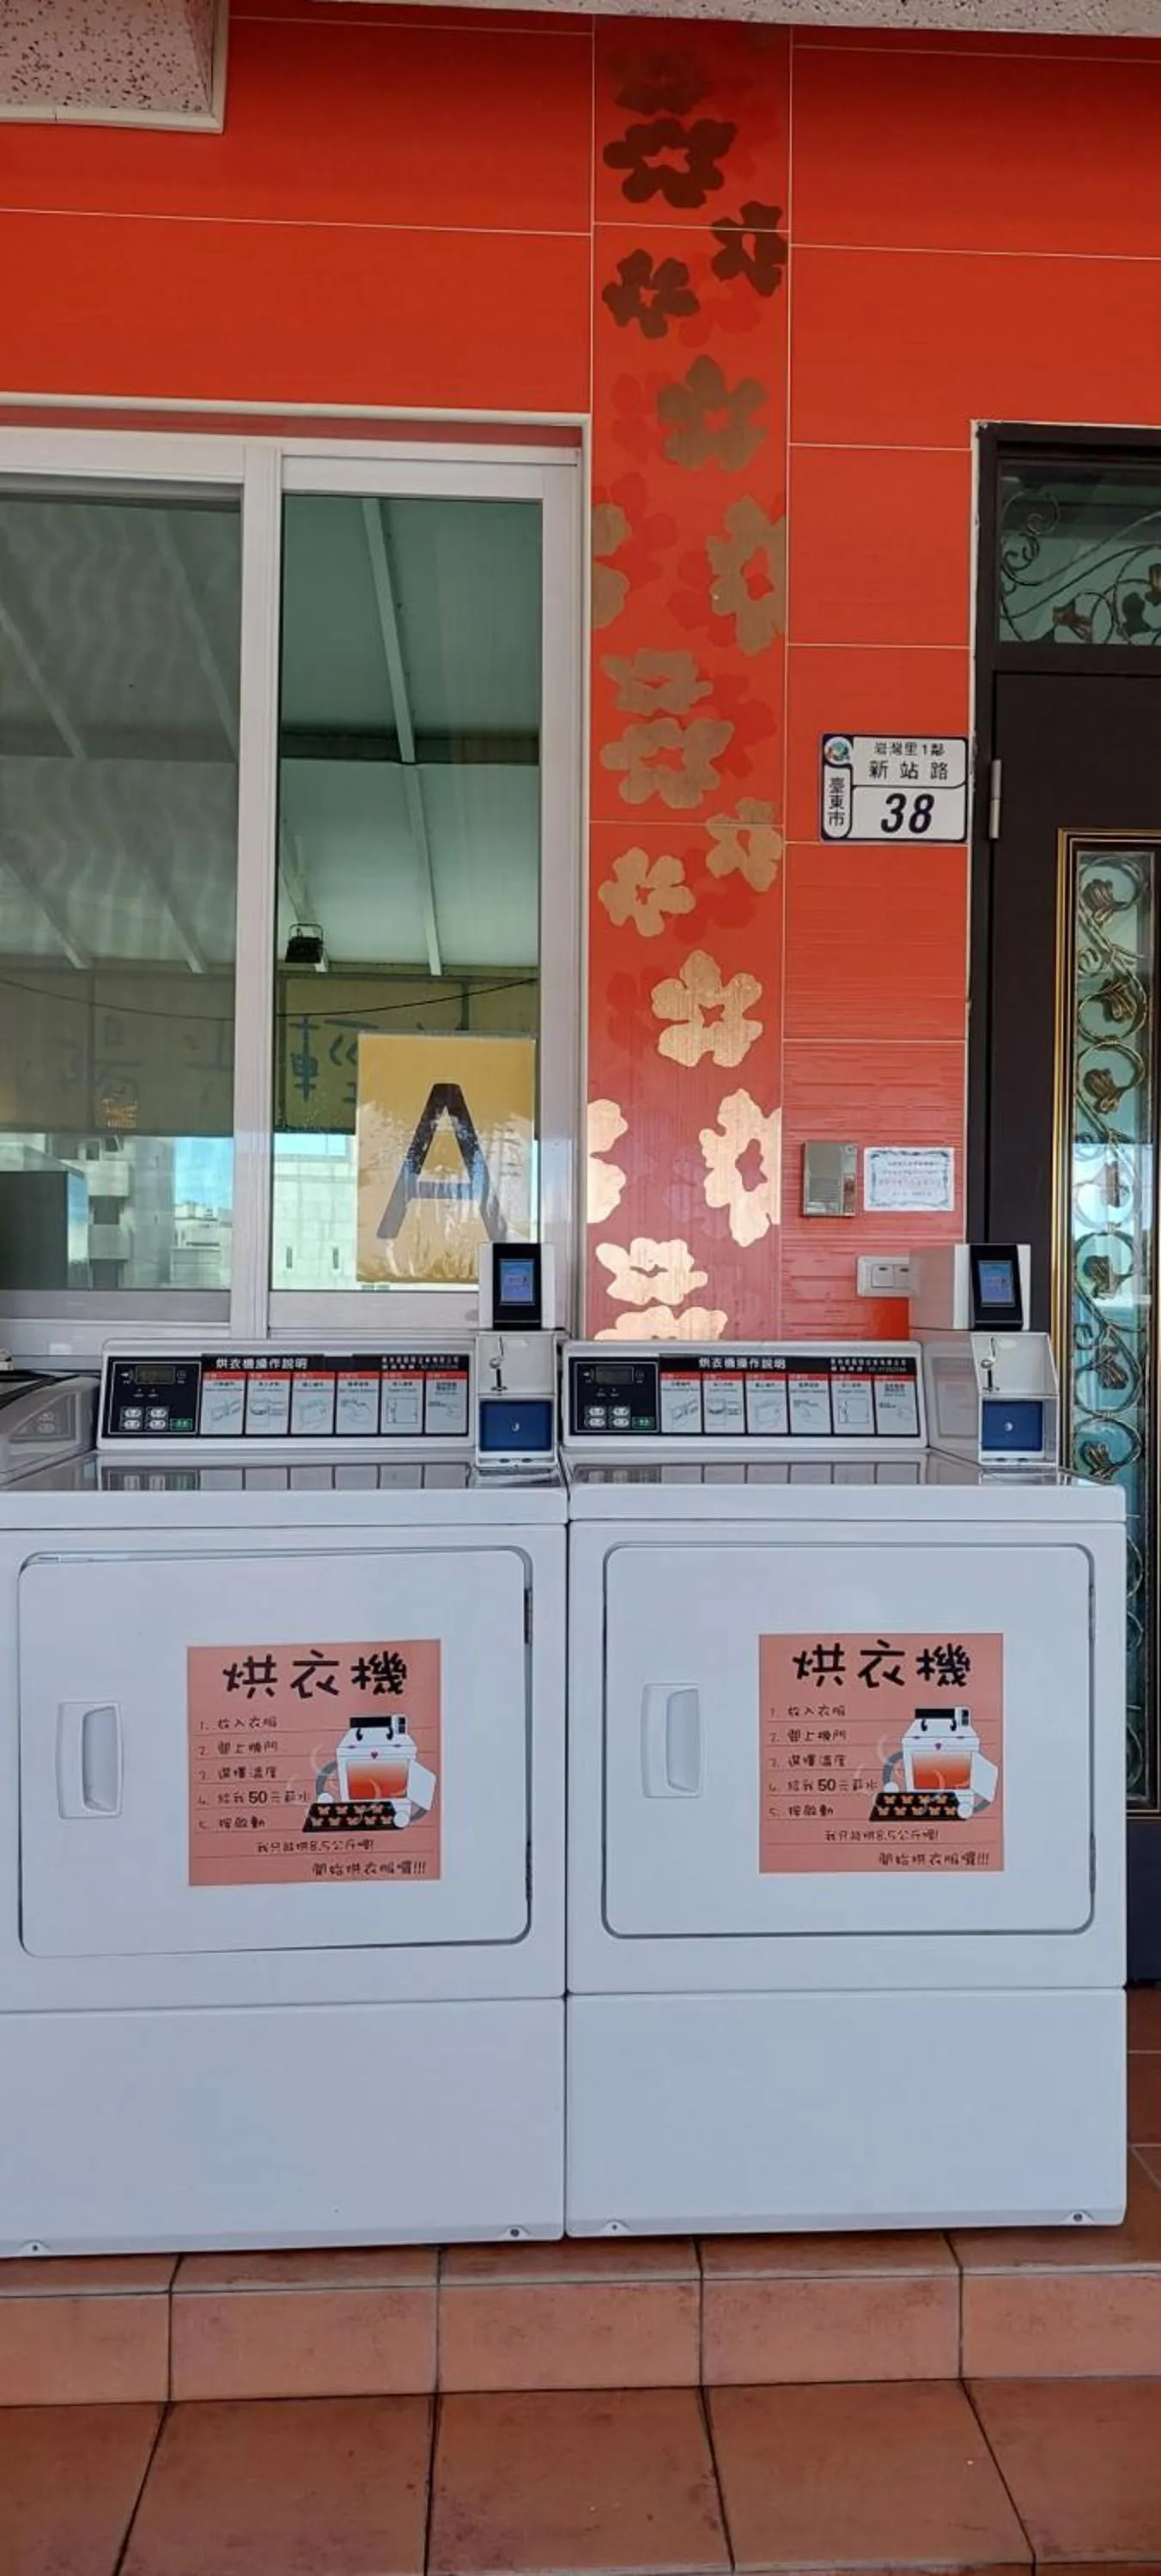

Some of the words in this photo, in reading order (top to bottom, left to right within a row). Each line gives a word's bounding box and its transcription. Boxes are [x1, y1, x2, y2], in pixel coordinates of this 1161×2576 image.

[868, 760, 948, 780] 新站路
[828, 777, 846, 827] 臺東市
[880, 793, 934, 834] 38
[377, 1083, 508, 1242] A
[222, 1649, 407, 1698] 烘衣機
[792, 1639, 971, 1688] 烘衣機
